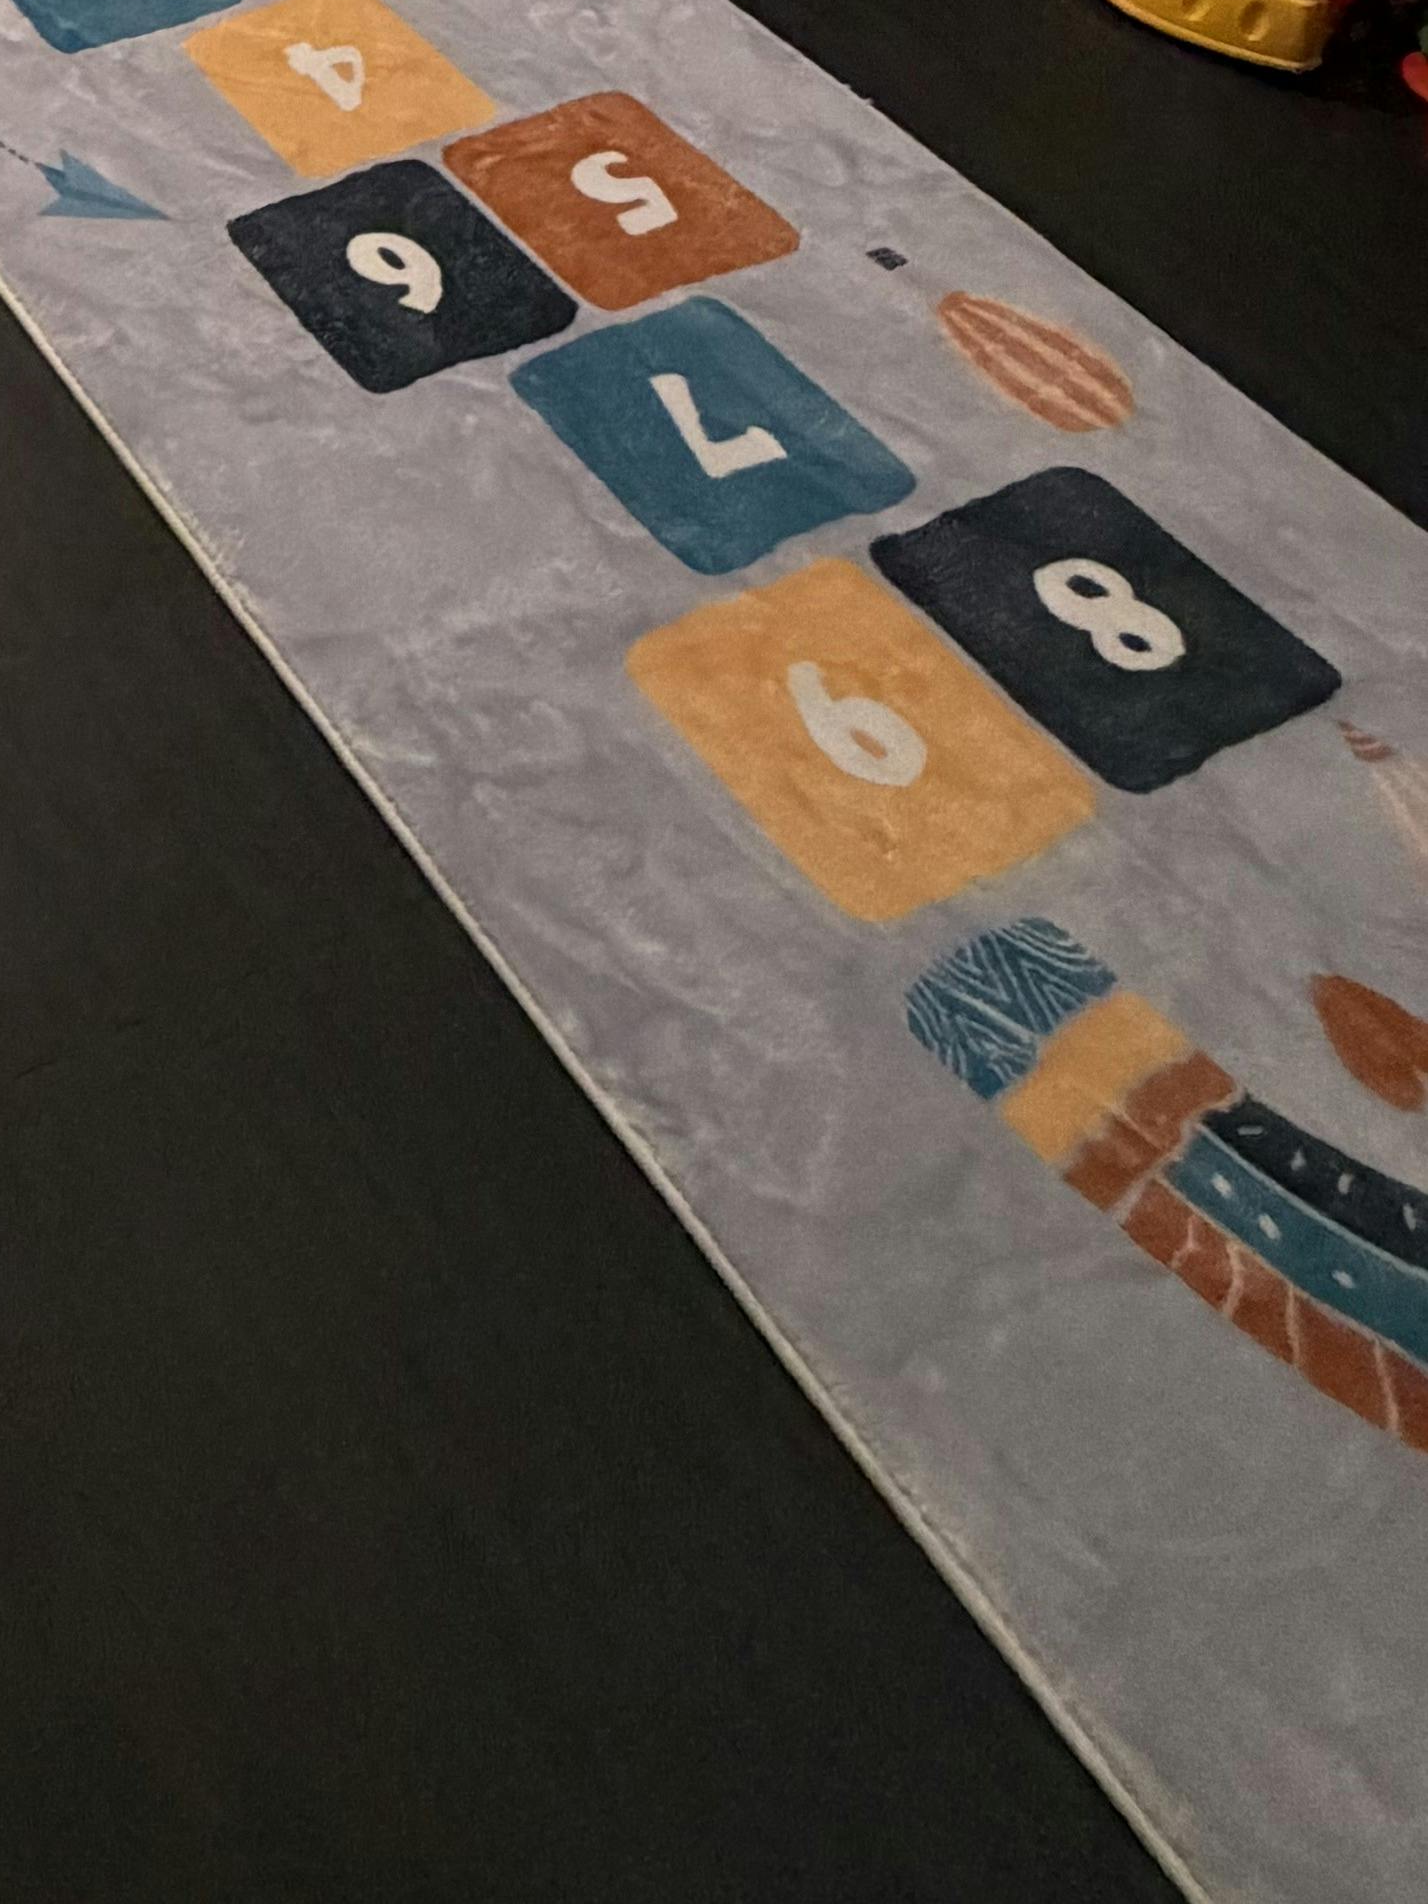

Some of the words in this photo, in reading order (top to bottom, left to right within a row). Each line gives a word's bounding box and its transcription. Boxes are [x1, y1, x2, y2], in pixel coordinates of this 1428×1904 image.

[283, 40, 366, 111] 4
[570, 149, 679, 236] 5
[649, 372, 788, 479] 7
[1032, 557, 1187, 672] 8
